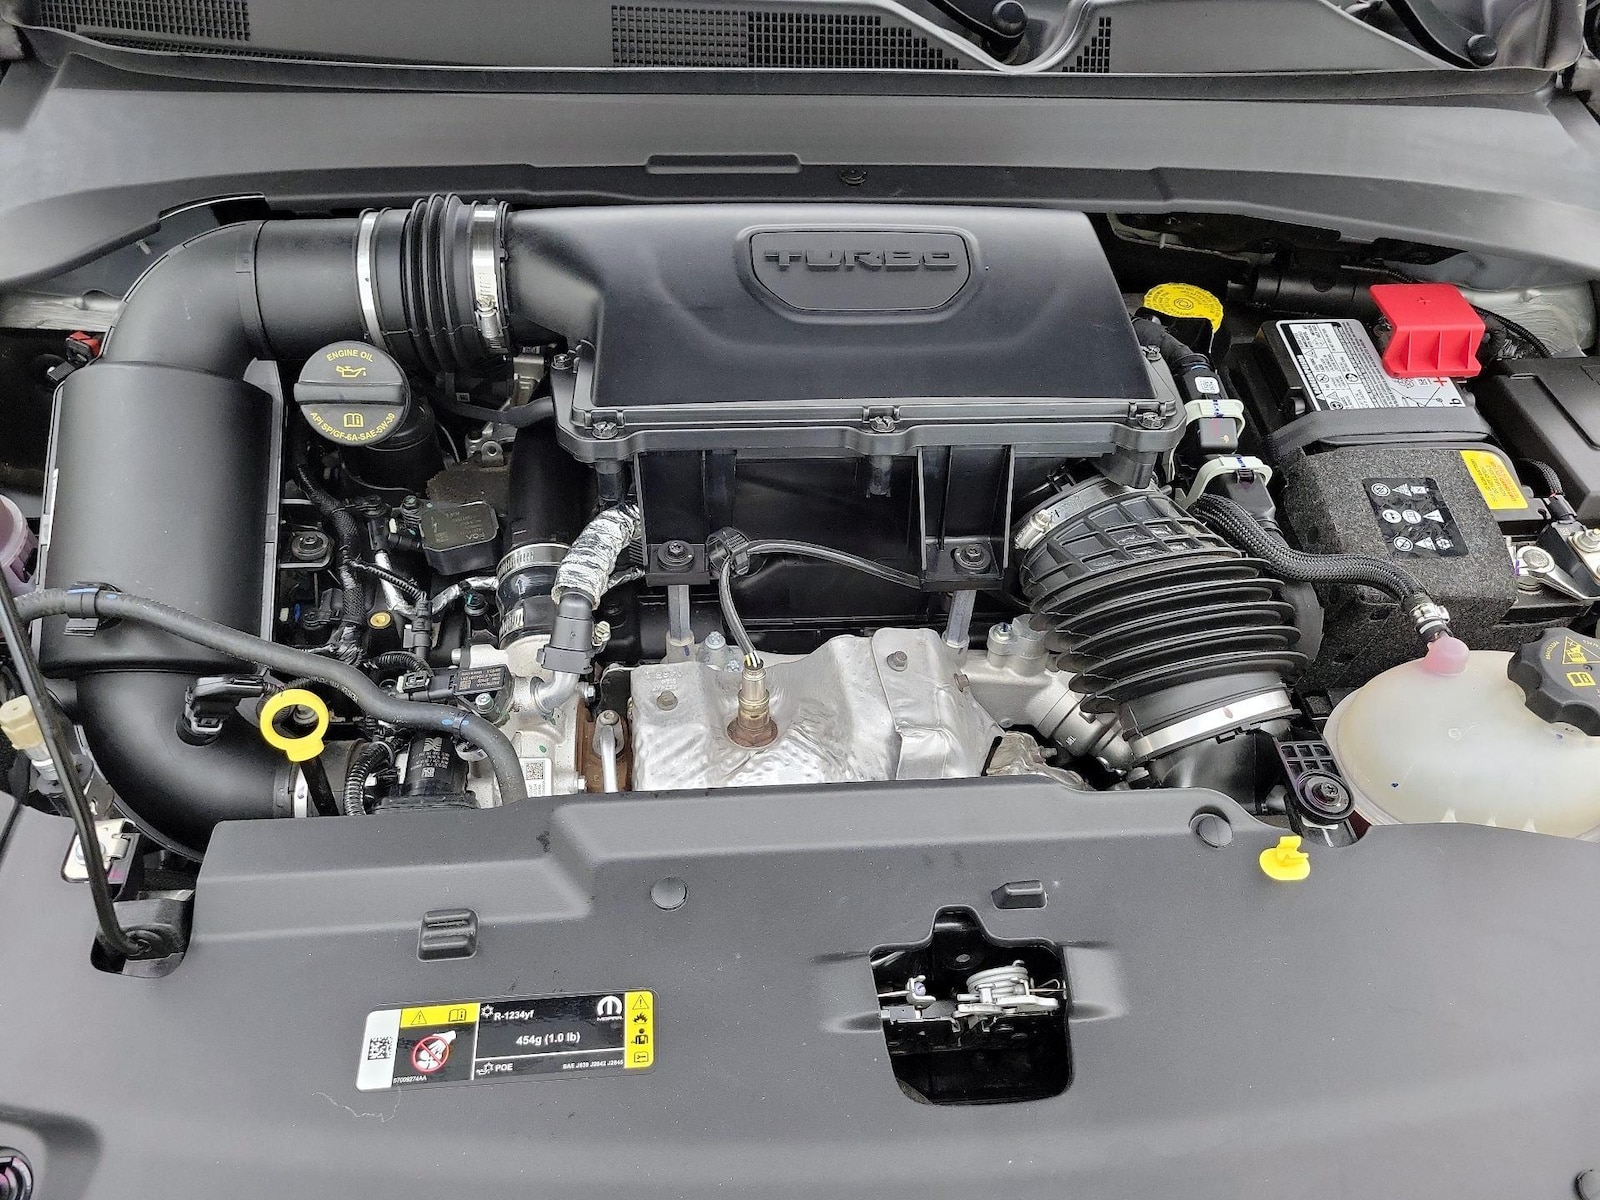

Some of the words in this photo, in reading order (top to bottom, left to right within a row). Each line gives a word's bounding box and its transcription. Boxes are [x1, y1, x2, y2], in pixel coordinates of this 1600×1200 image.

[764, 249, 958, 270] TURBO
[326, 349, 359, 362] ENGINE
[360, 351, 374, 363] OIL
[310, 412, 323, 425] API
[493, 1009, 535, 1021] R-1234yf
[515, 1033, 542, 1047] 454g
[543, 1032, 565, 1046] (1.0
[566, 1031, 581, 1044] lb)
[494, 1062, 514, 1072] POE
[562, 1062, 576, 1070] SAE
